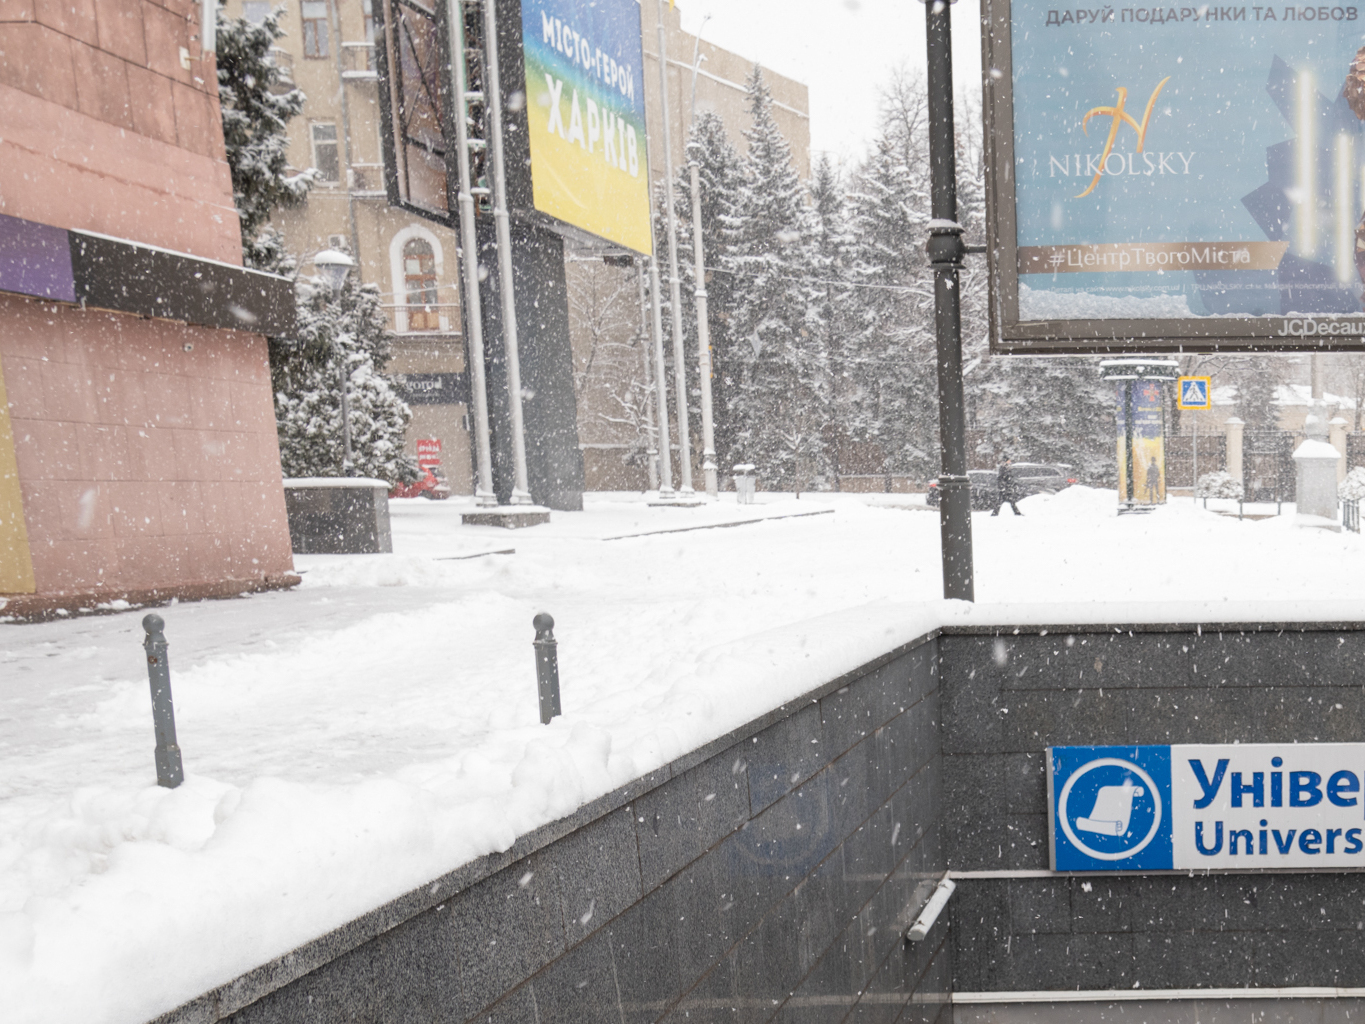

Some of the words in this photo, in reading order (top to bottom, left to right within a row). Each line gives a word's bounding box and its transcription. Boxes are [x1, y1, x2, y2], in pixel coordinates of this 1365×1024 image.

[1046, 5, 1114, 26] ДАРУЙ
[1121, 6, 1246, 25] ПОДАРУНКИ
[1253, 6, 1277, 22] ТА
[1282, 6, 1359, 22] ЛЮБОВ
[541, 10, 635, 102] МІСТО-ГЕРОЙ
[545, 73, 639, 178] ХАРКІВ
[1050, 152, 1196, 177] NIKOLSKY
[1050, 247, 1250, 270] #ЦентрТвогоМіста
